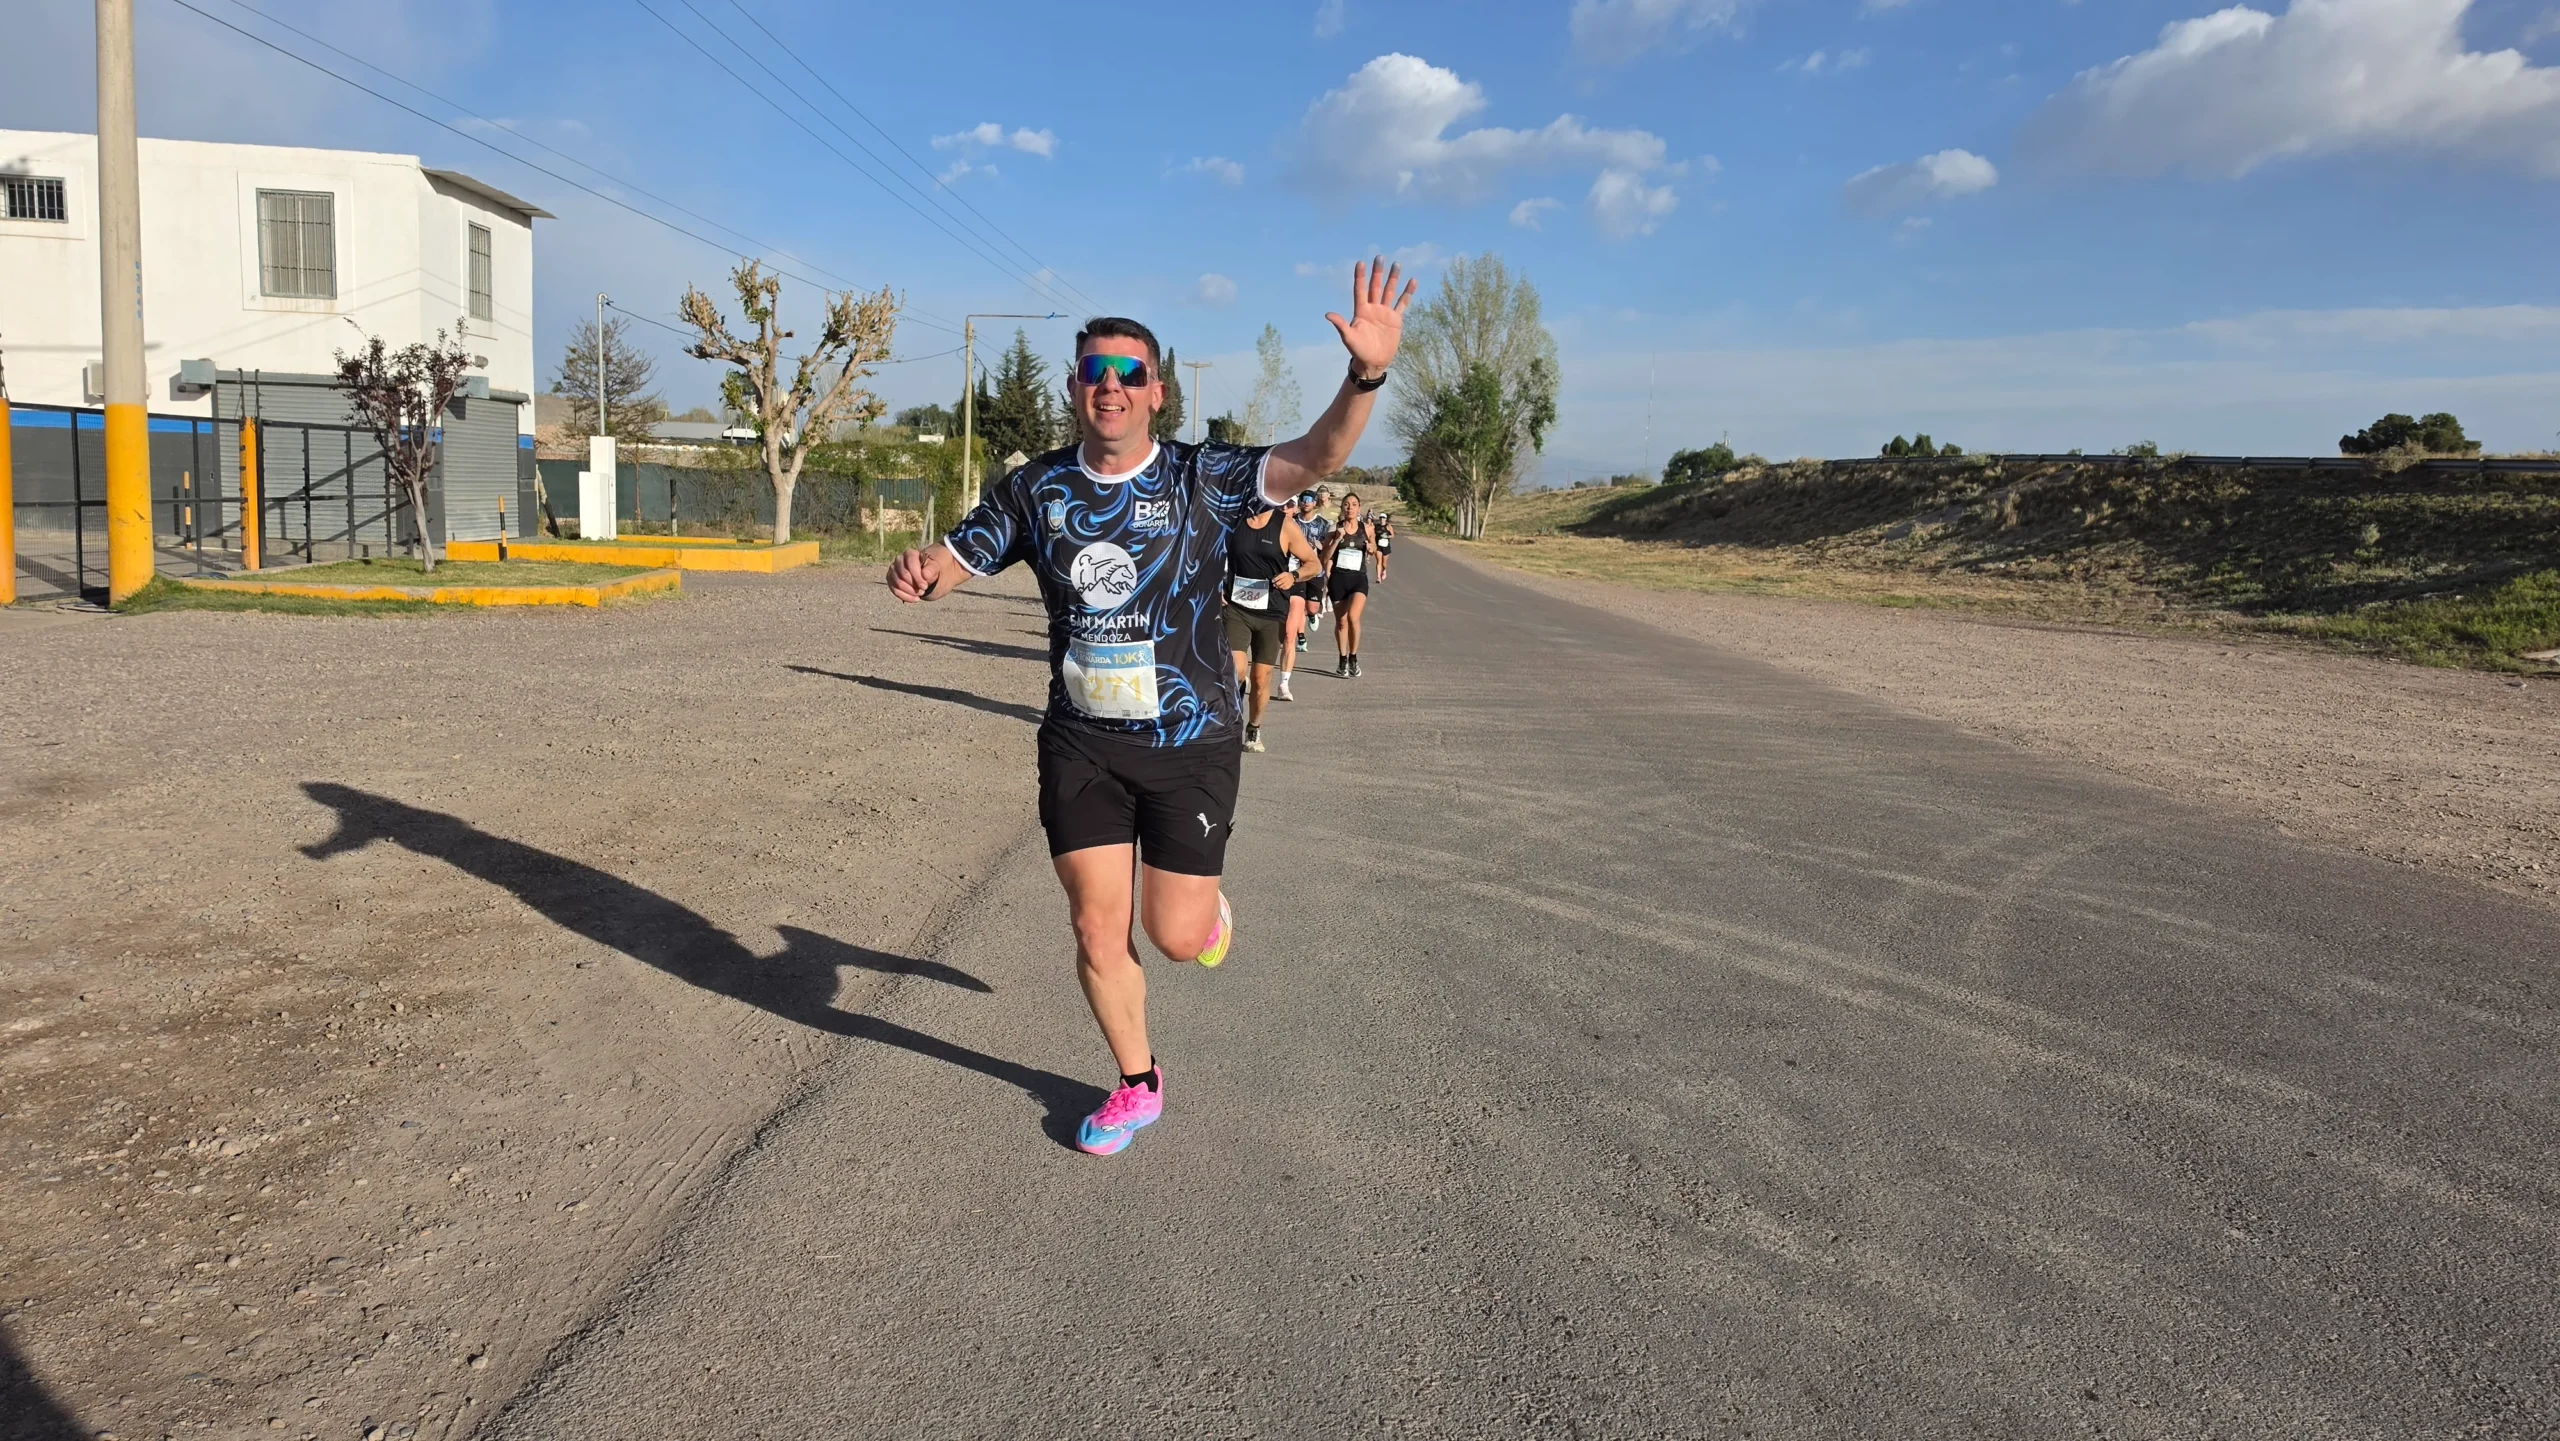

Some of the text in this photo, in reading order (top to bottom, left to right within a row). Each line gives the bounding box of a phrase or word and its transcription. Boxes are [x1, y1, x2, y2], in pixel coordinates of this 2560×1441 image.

[1070, 611, 1150, 629] SAN MARTÍN
[1081, 632, 1132, 643] MENDOZA
[1113, 651, 1138, 665] 10K
[1073, 675, 1143, 702] 1271
